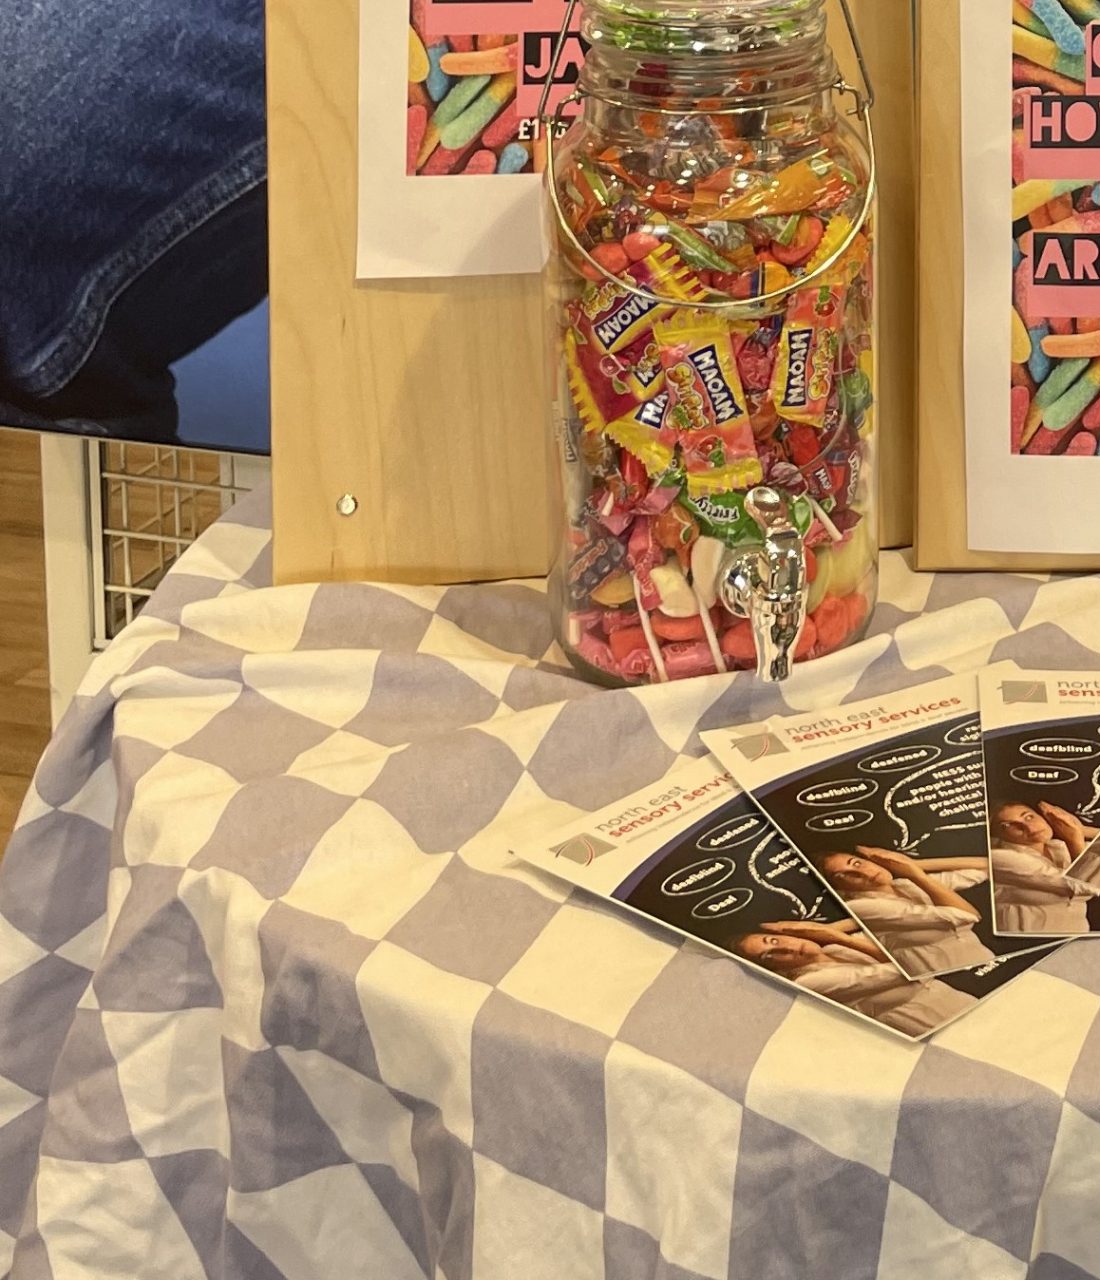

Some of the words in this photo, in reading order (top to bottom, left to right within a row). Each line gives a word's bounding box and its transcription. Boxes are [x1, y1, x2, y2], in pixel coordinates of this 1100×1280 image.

[518, 119, 540, 139] £1
[787, 333, 809, 404] MAOAM
[694, 350, 737, 420] MAOAM
[785, 719, 840, 735] north
[847, 706, 888, 720] east
[793, 720, 872, 743] sensory
[879, 696, 962, 724] services
[1029, 745, 1092, 753] deafblind
[870, 750, 928, 769] deafened
[1028, 770, 1060, 779] Deaf
[806, 783, 868, 801] deafblind
[910, 780, 952, 796] people
[594, 803, 648, 833] north
[649, 785, 689, 806] east
[896, 793, 937, 808] and/or
[609, 800, 682, 838] sensory
[823, 815, 855, 827] Deaf
[710, 818, 760, 847] deafened
[708, 894, 738, 912] Deaf
